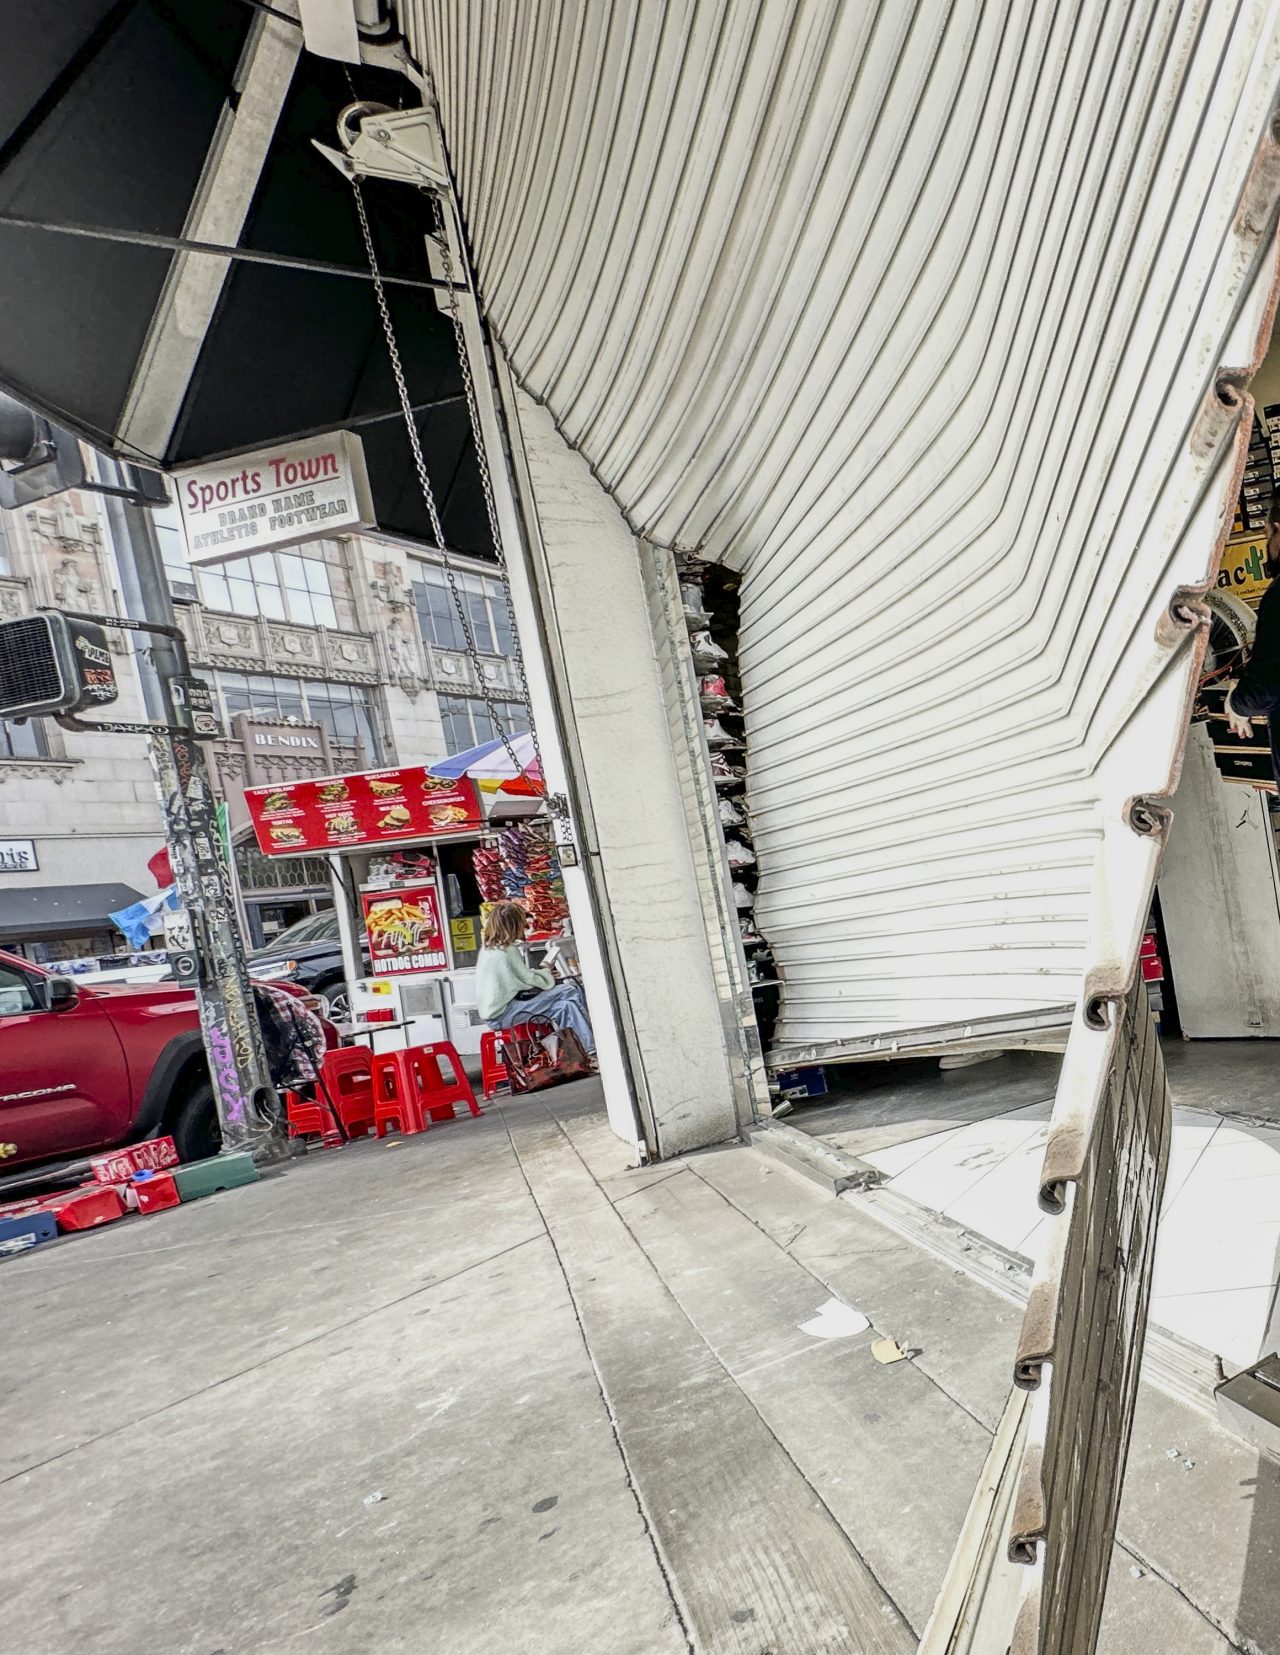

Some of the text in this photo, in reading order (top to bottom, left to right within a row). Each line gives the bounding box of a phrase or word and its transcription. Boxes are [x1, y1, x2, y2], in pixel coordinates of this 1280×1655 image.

[187, 453, 339, 514] Sports Town
[219, 490, 315, 527] BRAND NAME
[269, 499, 348, 530] FOOTWEAR
[254, 733, 318, 748] BENDIX
[374, 952, 446, 973] HOTDOG COMBO
[0, 1083, 77, 1101] ACOMA
